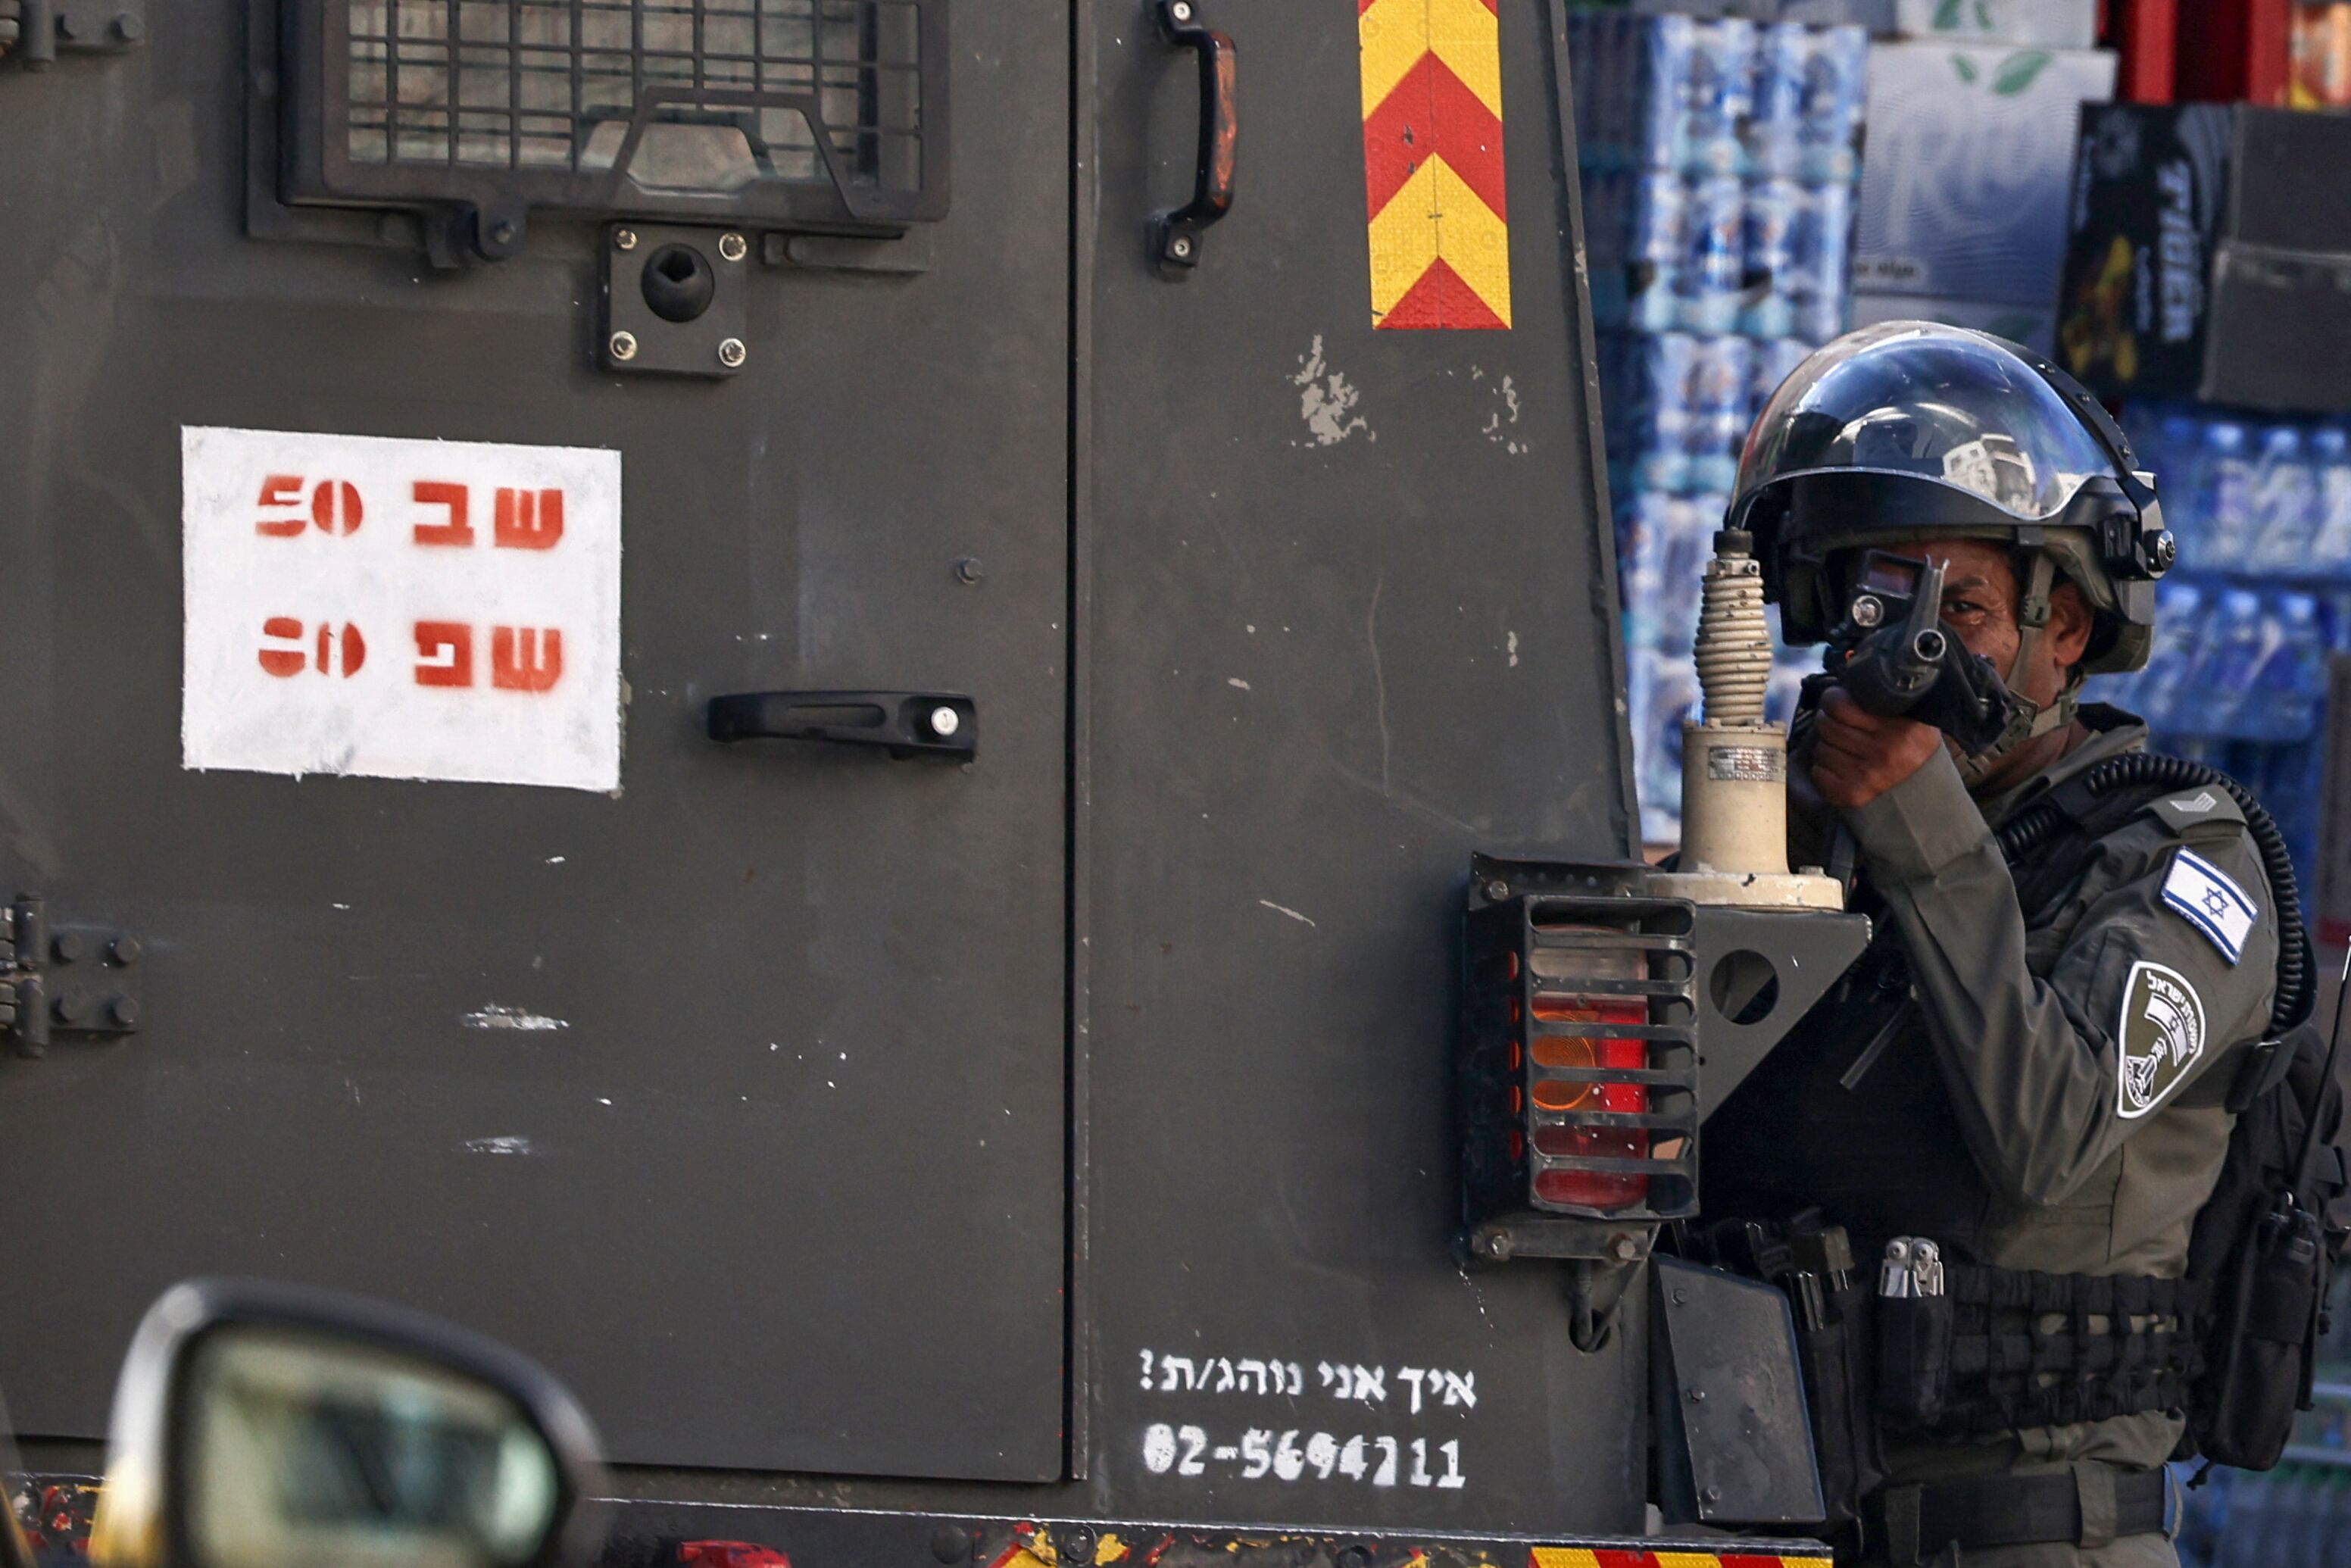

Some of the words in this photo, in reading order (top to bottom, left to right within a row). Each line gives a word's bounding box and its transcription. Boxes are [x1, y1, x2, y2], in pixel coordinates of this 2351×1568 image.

[254, 474, 364, 537] 50
[412, 480, 564, 551] שב
[258, 616, 367, 679] 80
[2146, 970, 2187, 1004] ישראל
[1317, 1360, 1388, 1402] אני
[1396, 1365, 1478, 1415] איך
